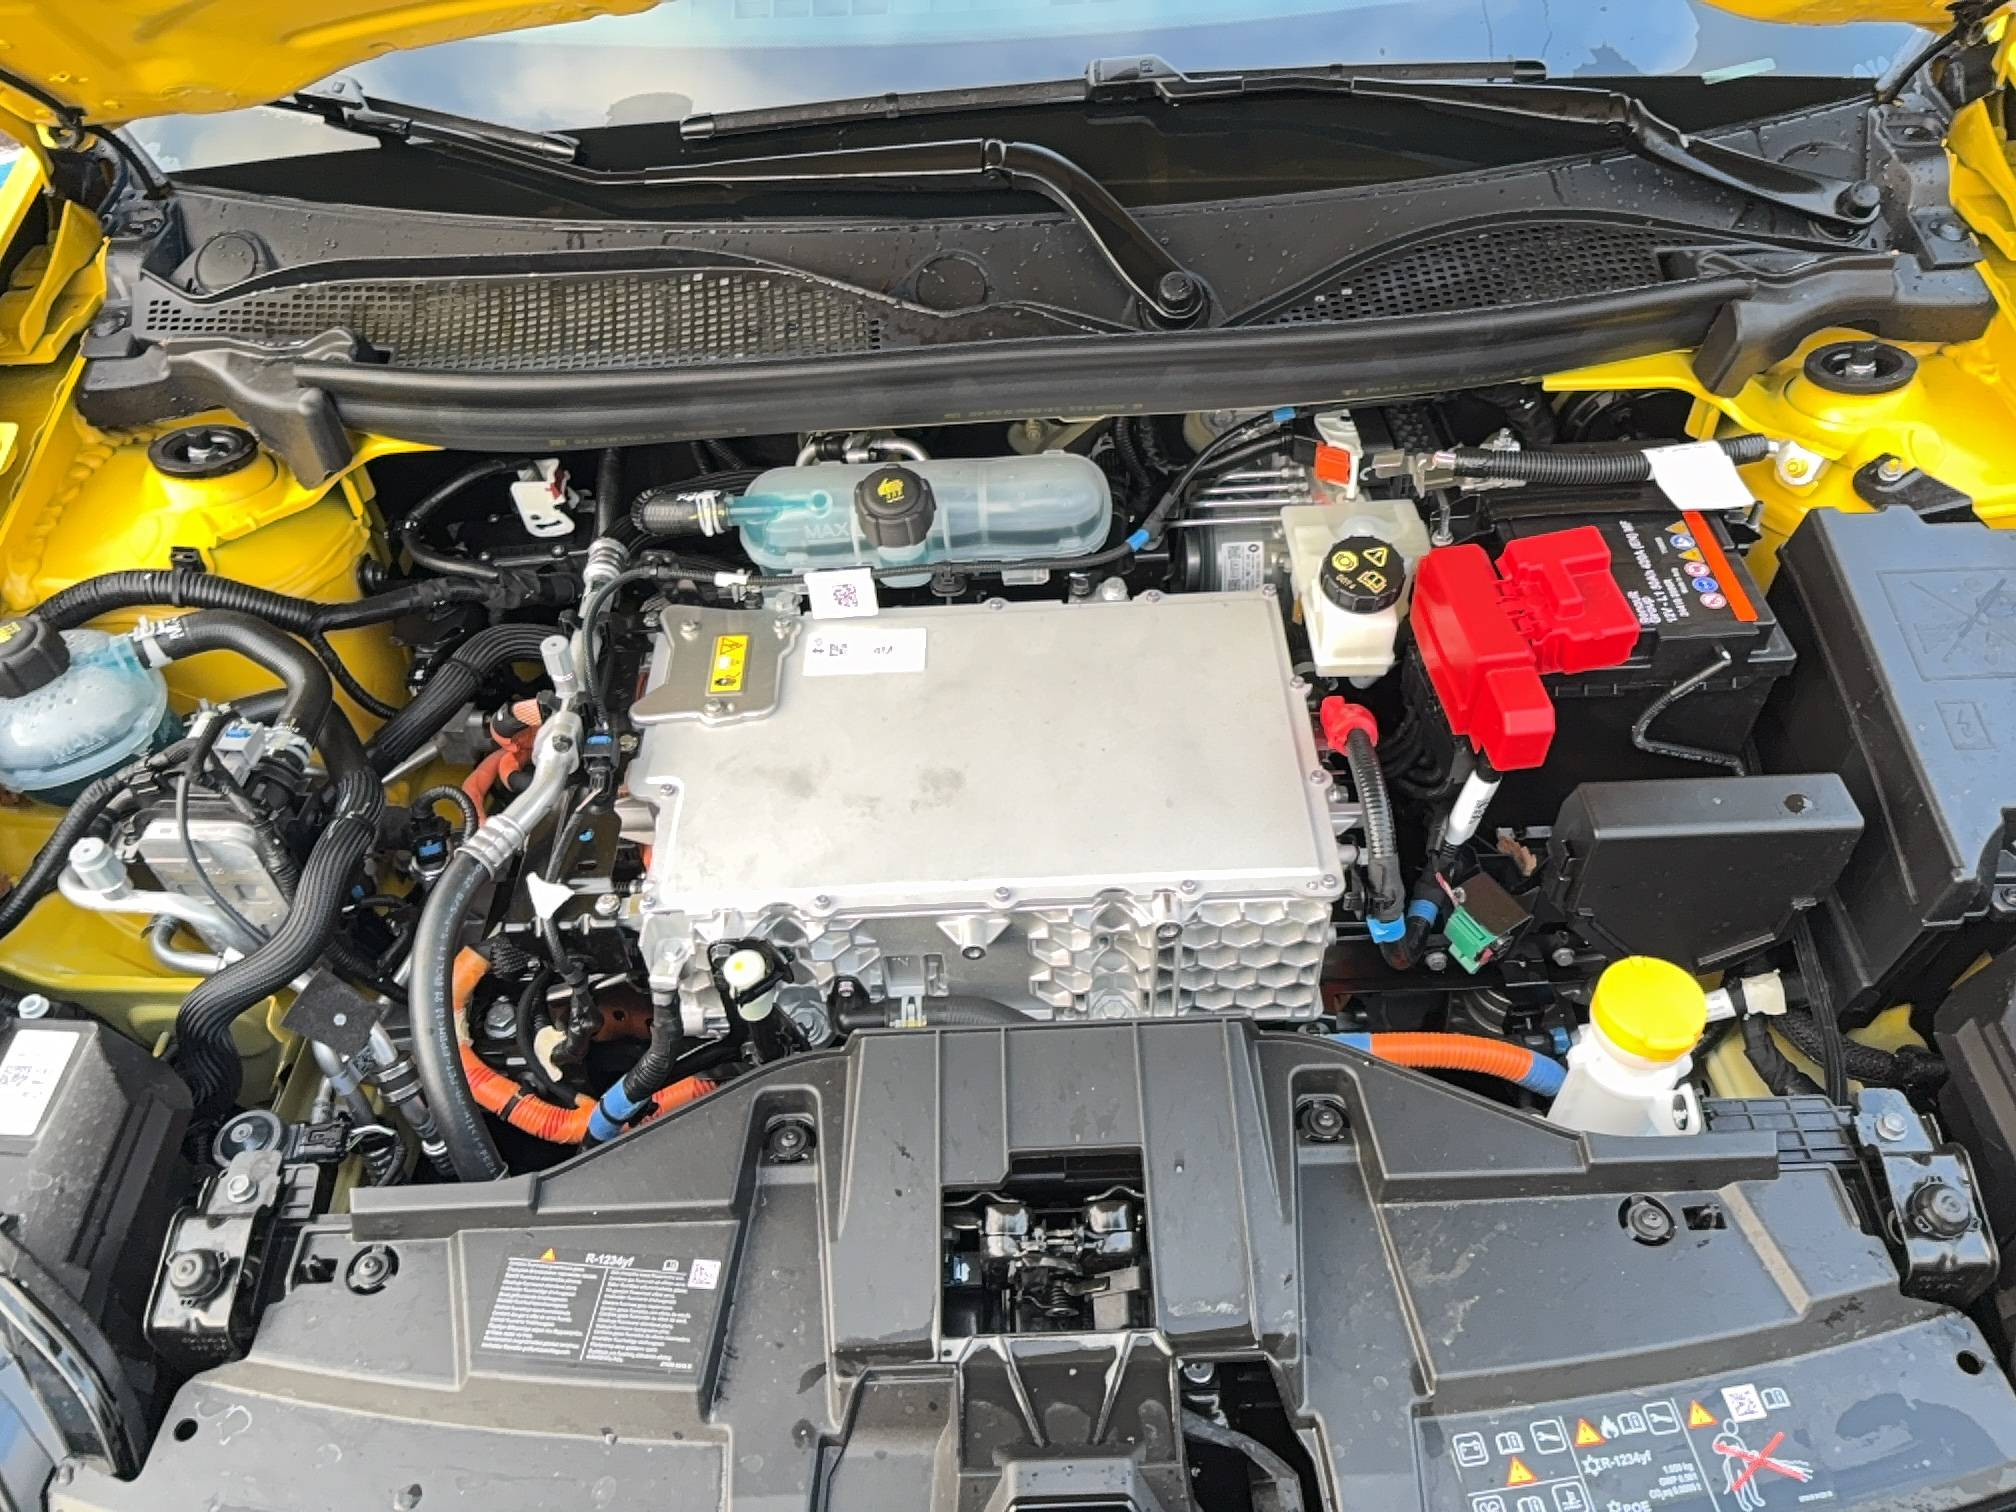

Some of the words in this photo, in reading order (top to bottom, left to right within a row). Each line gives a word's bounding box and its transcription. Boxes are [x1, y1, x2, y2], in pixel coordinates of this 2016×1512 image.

[803, 522, 851, 538] MAX
[585, 1252, 635, 1269] R-1234yf
[1601, 1449, 1652, 1469] R-1234yf
